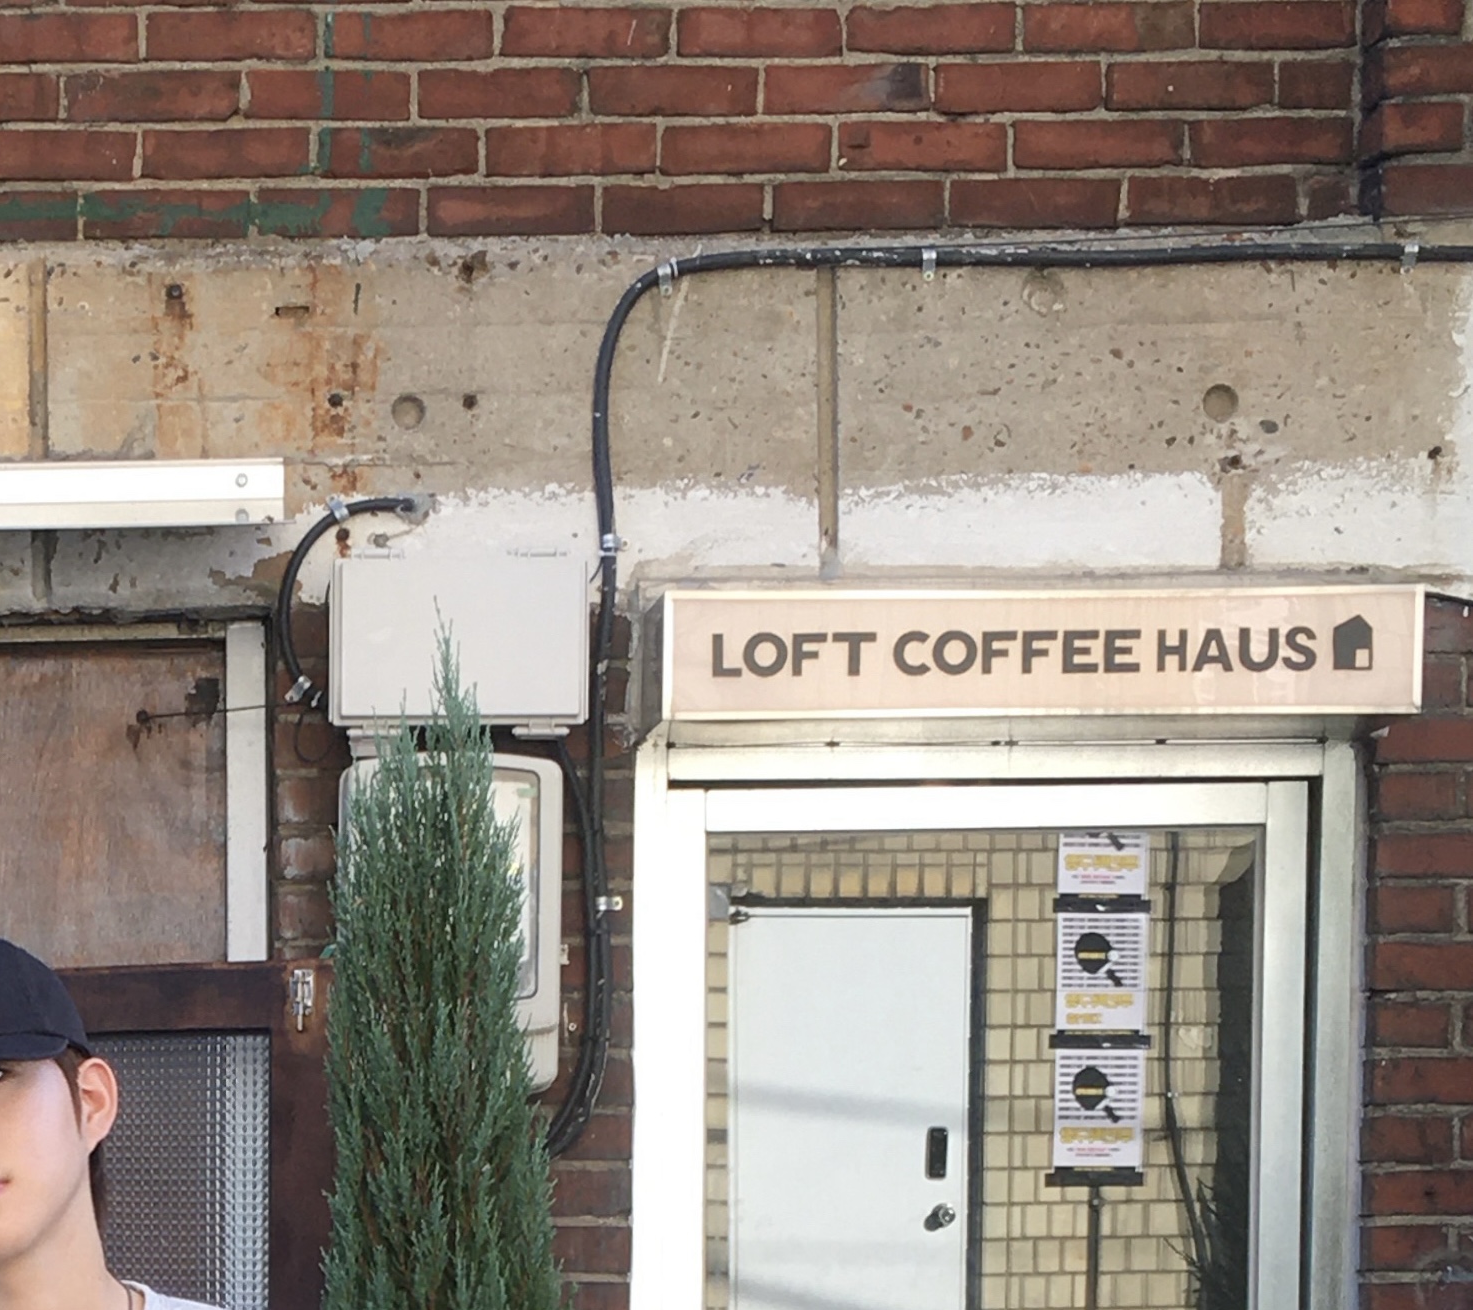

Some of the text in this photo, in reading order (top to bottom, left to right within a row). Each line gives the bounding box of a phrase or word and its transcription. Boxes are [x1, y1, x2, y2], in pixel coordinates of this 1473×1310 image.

[711, 625, 1318, 678] LOFT COFFEE HAUS
